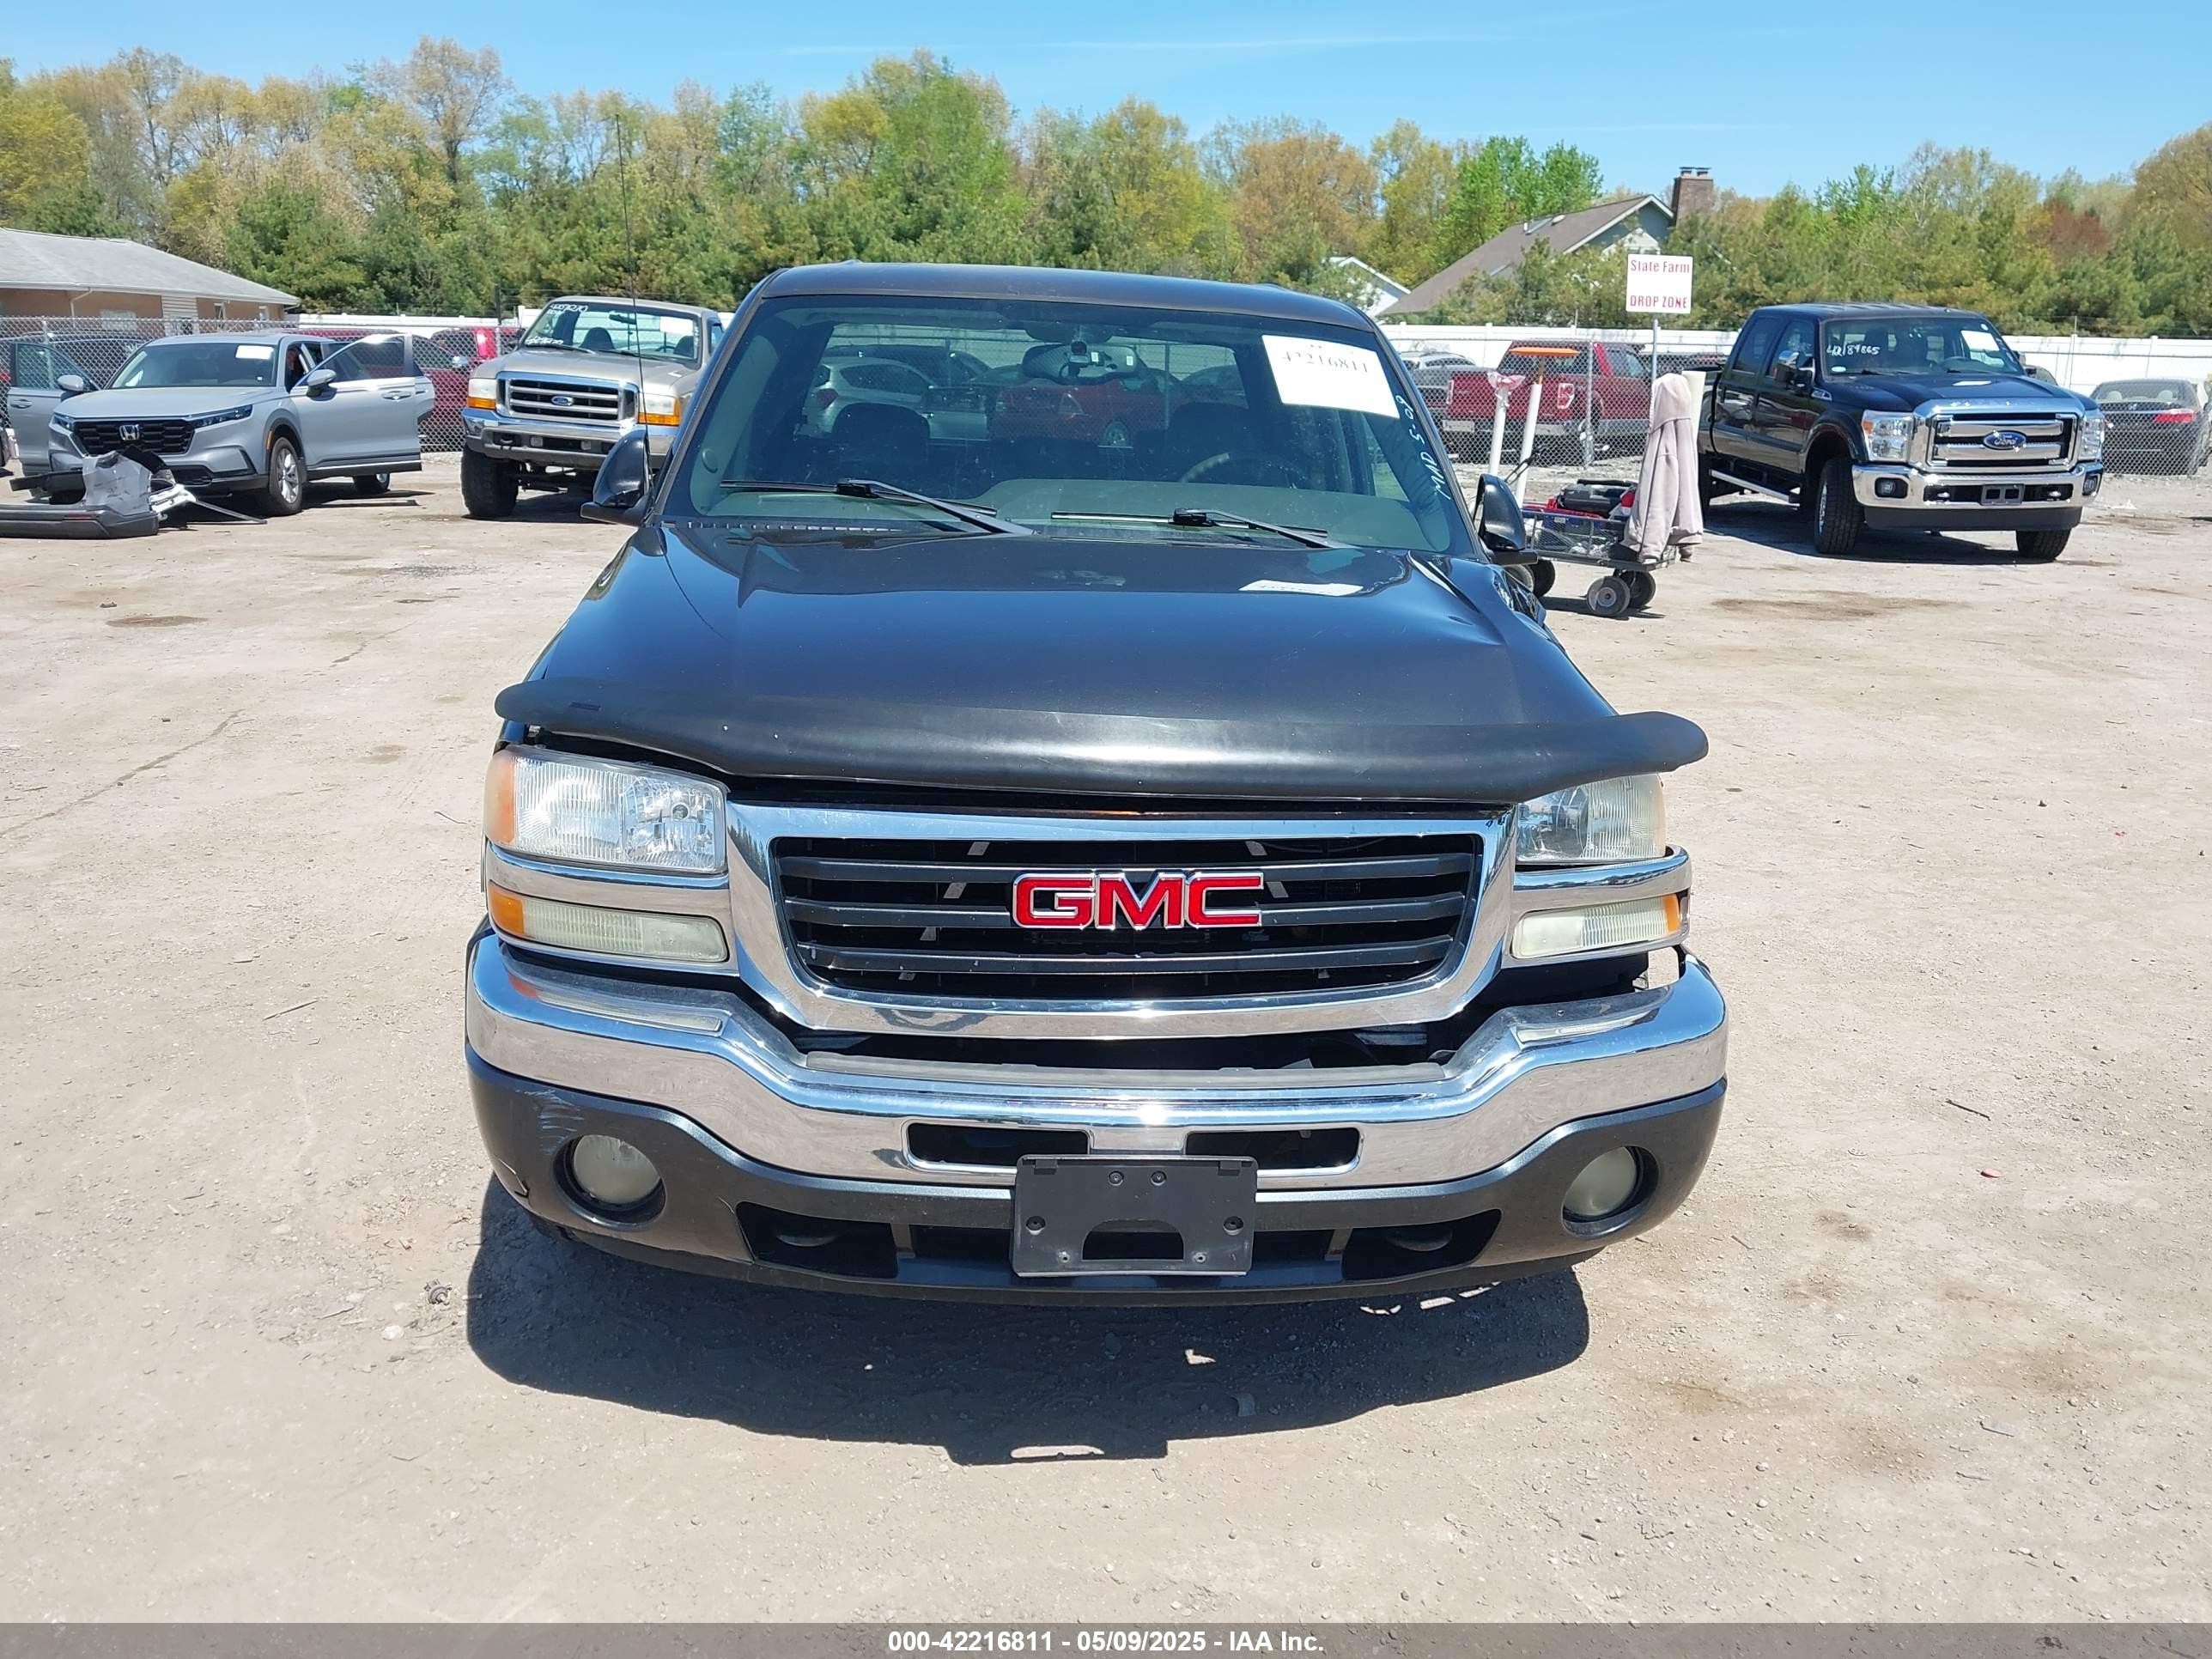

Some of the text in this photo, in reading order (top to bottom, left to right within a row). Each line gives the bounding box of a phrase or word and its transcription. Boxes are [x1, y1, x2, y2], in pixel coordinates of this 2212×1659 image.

[1630, 259, 1690, 274] State Farm
[1630, 295, 1687, 309] DROP ZONE
[1420, 451, 1451, 501] MAD
[1012, 871, 1264, 931] GMC
